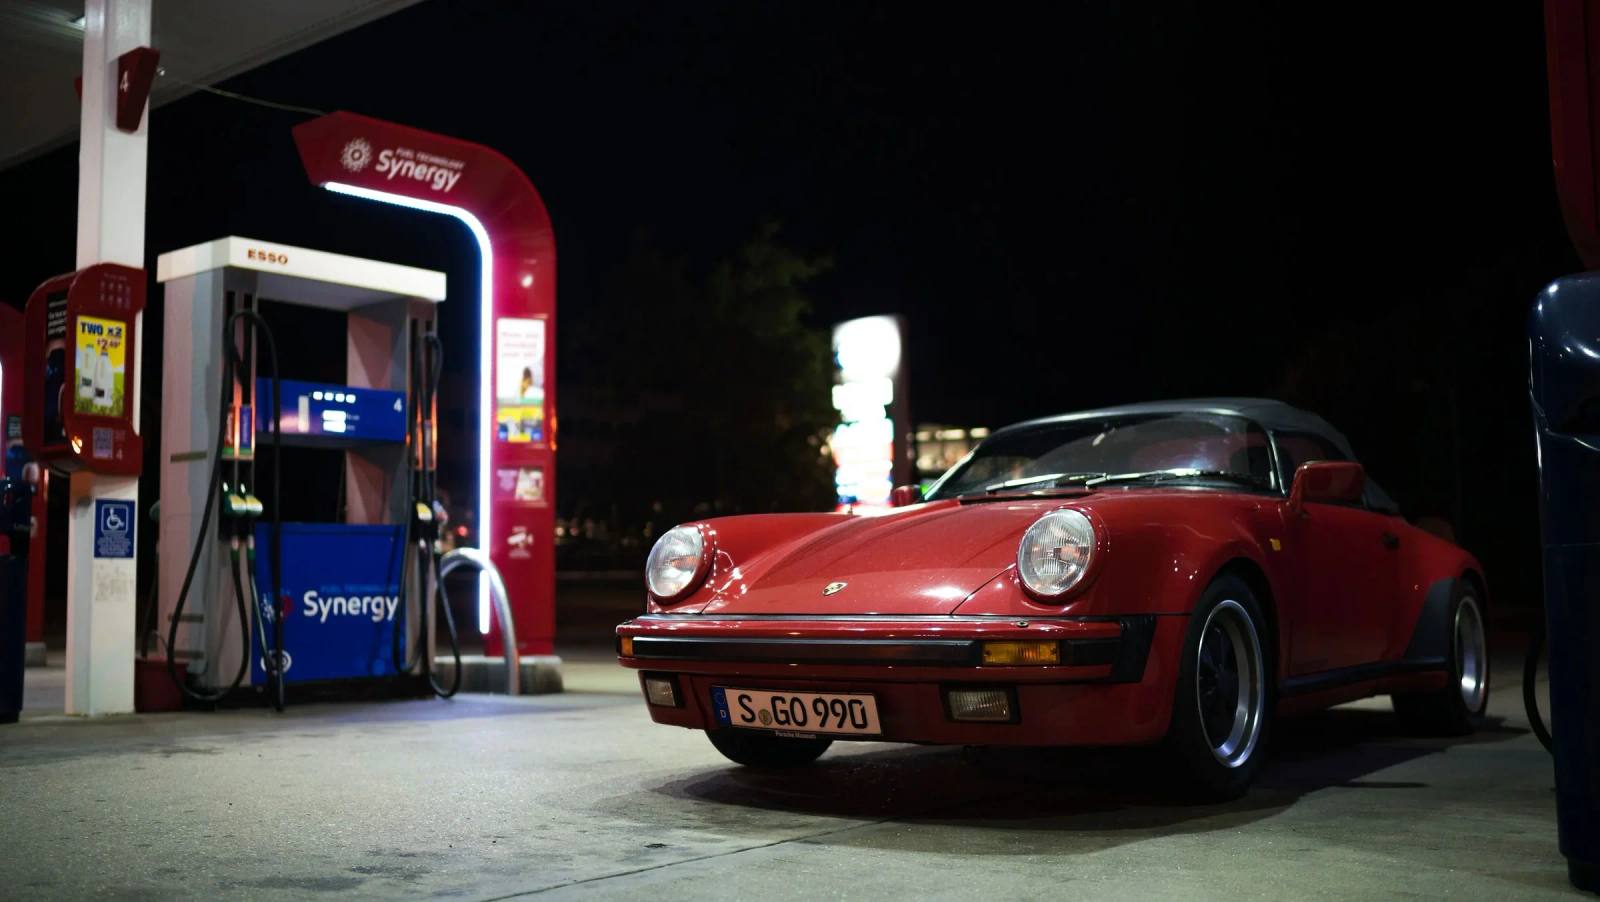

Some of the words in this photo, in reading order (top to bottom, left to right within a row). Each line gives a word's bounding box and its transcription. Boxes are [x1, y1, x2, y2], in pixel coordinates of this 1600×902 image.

[119, 70, 129, 92] 4
[375, 149, 461, 192] Synergy
[247, 248, 288, 265] ESSO
[81, 322, 103, 336] TWO
[393, 397, 403, 412] 4
[303, 589, 399, 624] Synergy
[720, 709, 727, 718] D
[737, 694, 756, 722] S
[771, 696, 808, 727] GO
[812, 697, 868, 729] 990
